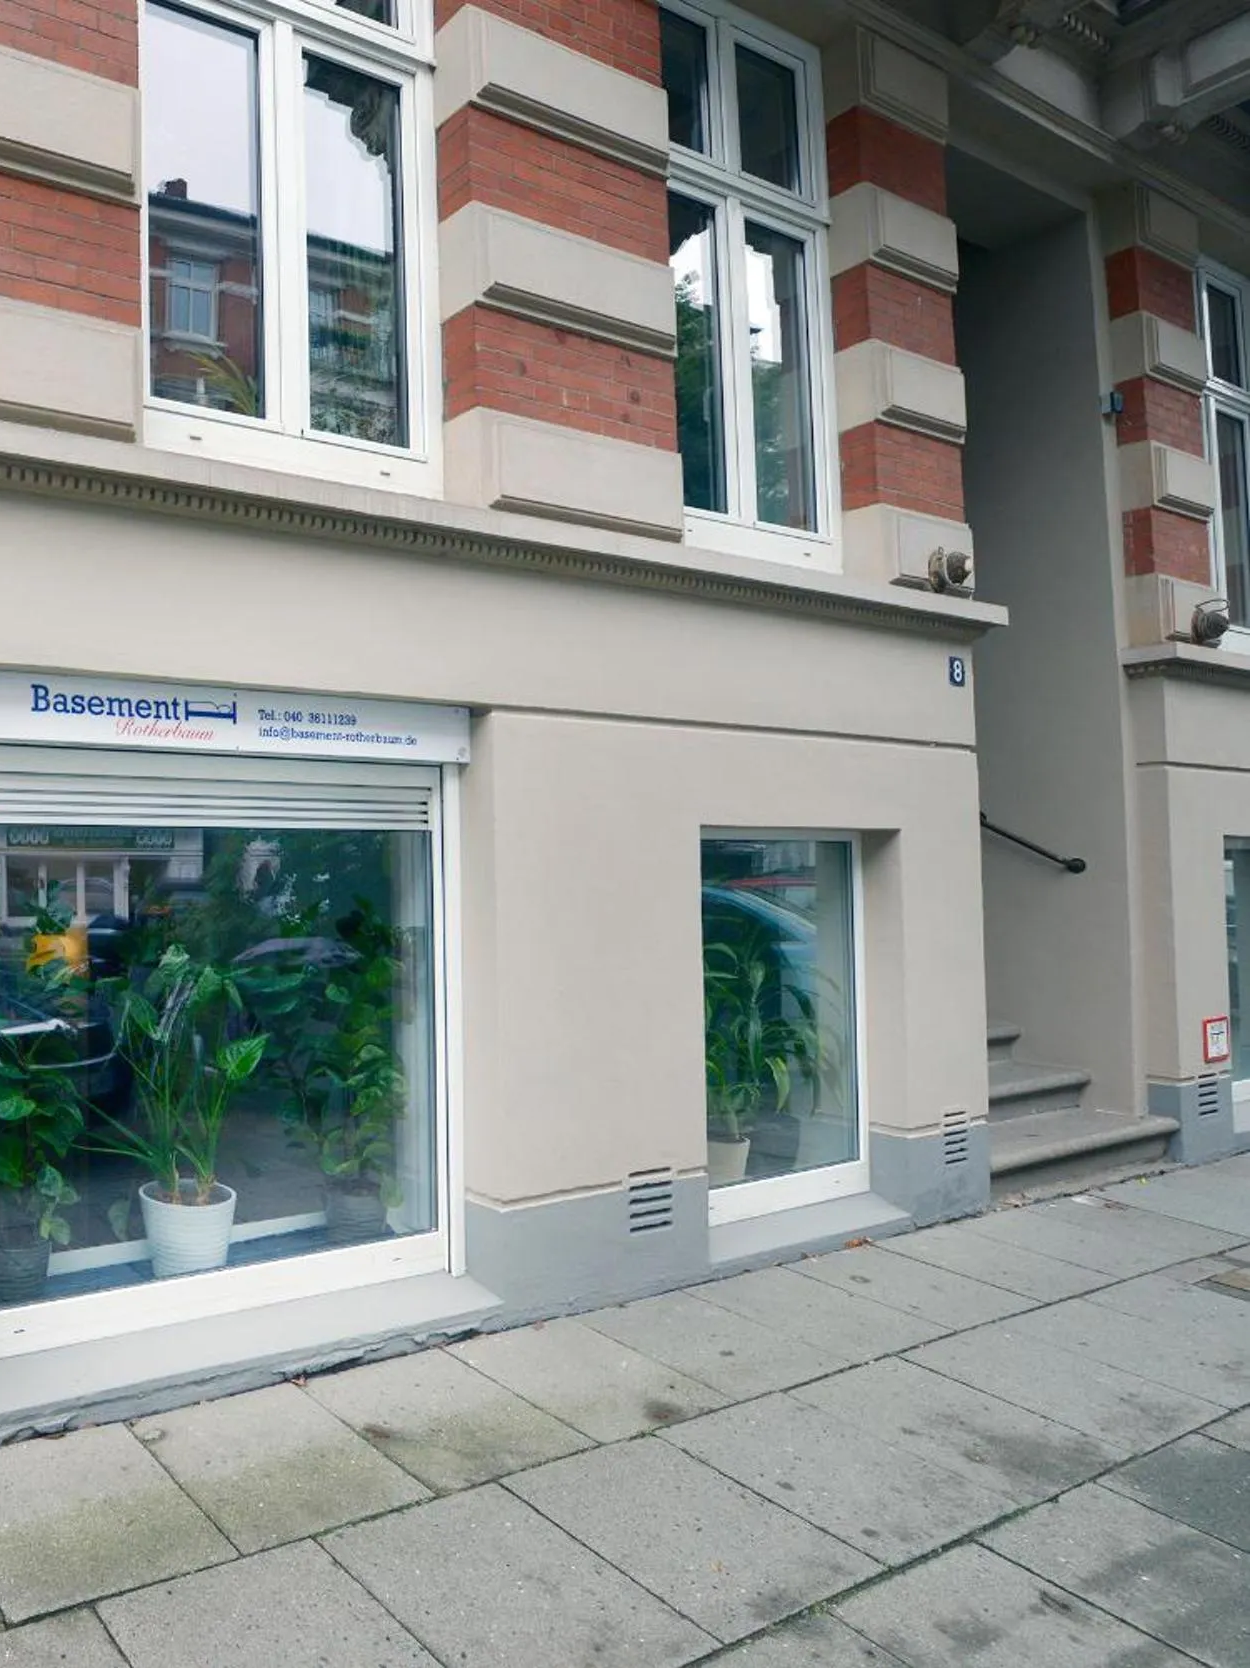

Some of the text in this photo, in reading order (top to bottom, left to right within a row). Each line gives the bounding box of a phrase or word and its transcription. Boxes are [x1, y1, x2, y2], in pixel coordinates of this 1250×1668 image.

[953, 660, 963, 682] 8
[31, 684, 181, 720] Basement
[284, 711, 303, 723] 040
[117, 719, 215, 740] Rotherbaum
